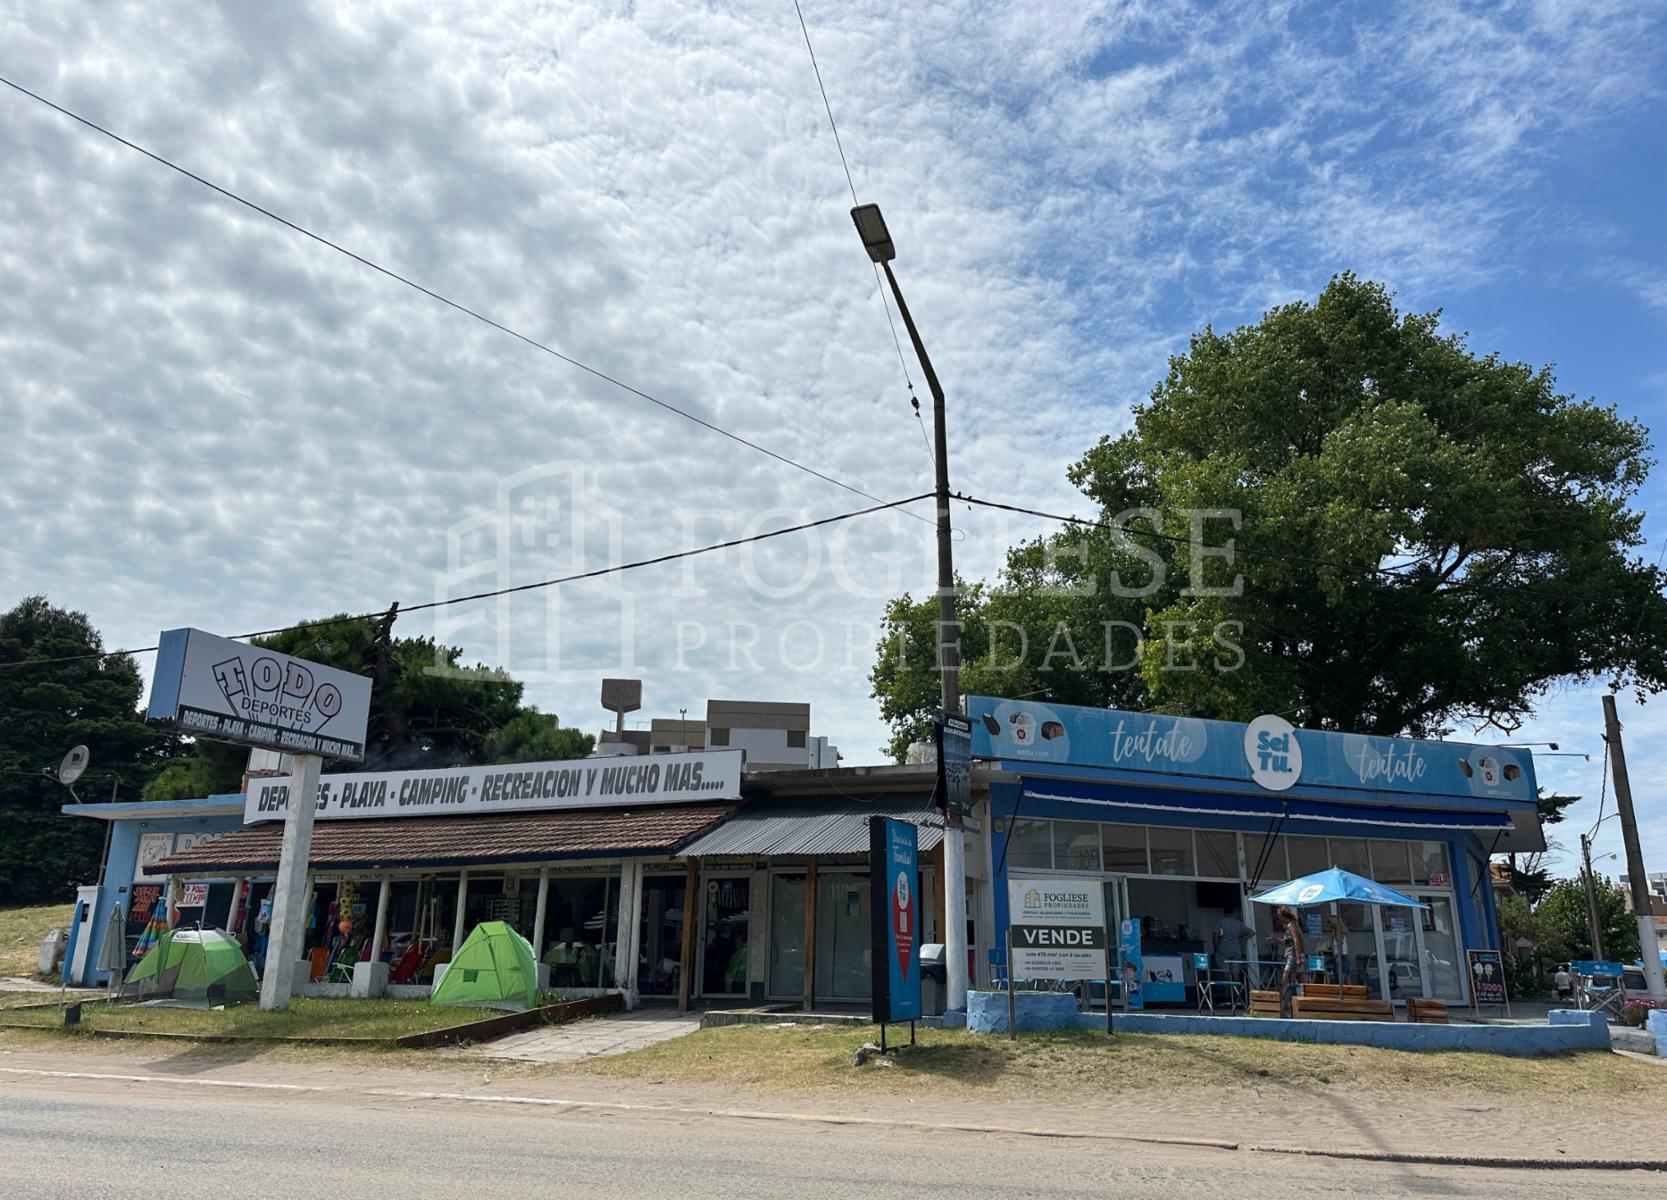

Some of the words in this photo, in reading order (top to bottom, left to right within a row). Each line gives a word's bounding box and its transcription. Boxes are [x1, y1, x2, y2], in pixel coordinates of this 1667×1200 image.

[212, 655, 343, 718] TODO
[182, 710, 220, 731] DEPORTES
[222, 718, 245, 736] PLAYA
[241, 696, 312, 723] DEPORTES
[1108, 719, 1195, 763] tentate
[1256, 730, 1290, 753] Sei
[1355, 742, 1427, 784] tentate
[340, 780, 388, 809] PLAYA
[398, 775, 470, 807] CAMPING
[480, 767, 582, 802] RECREACION
[585, 768, 598, 796] Y
[599, 763, 660, 796] MUCHO
[1044, 893, 1089, 903] FOGLIESE
[1023, 928, 1094, 945] VENDE
